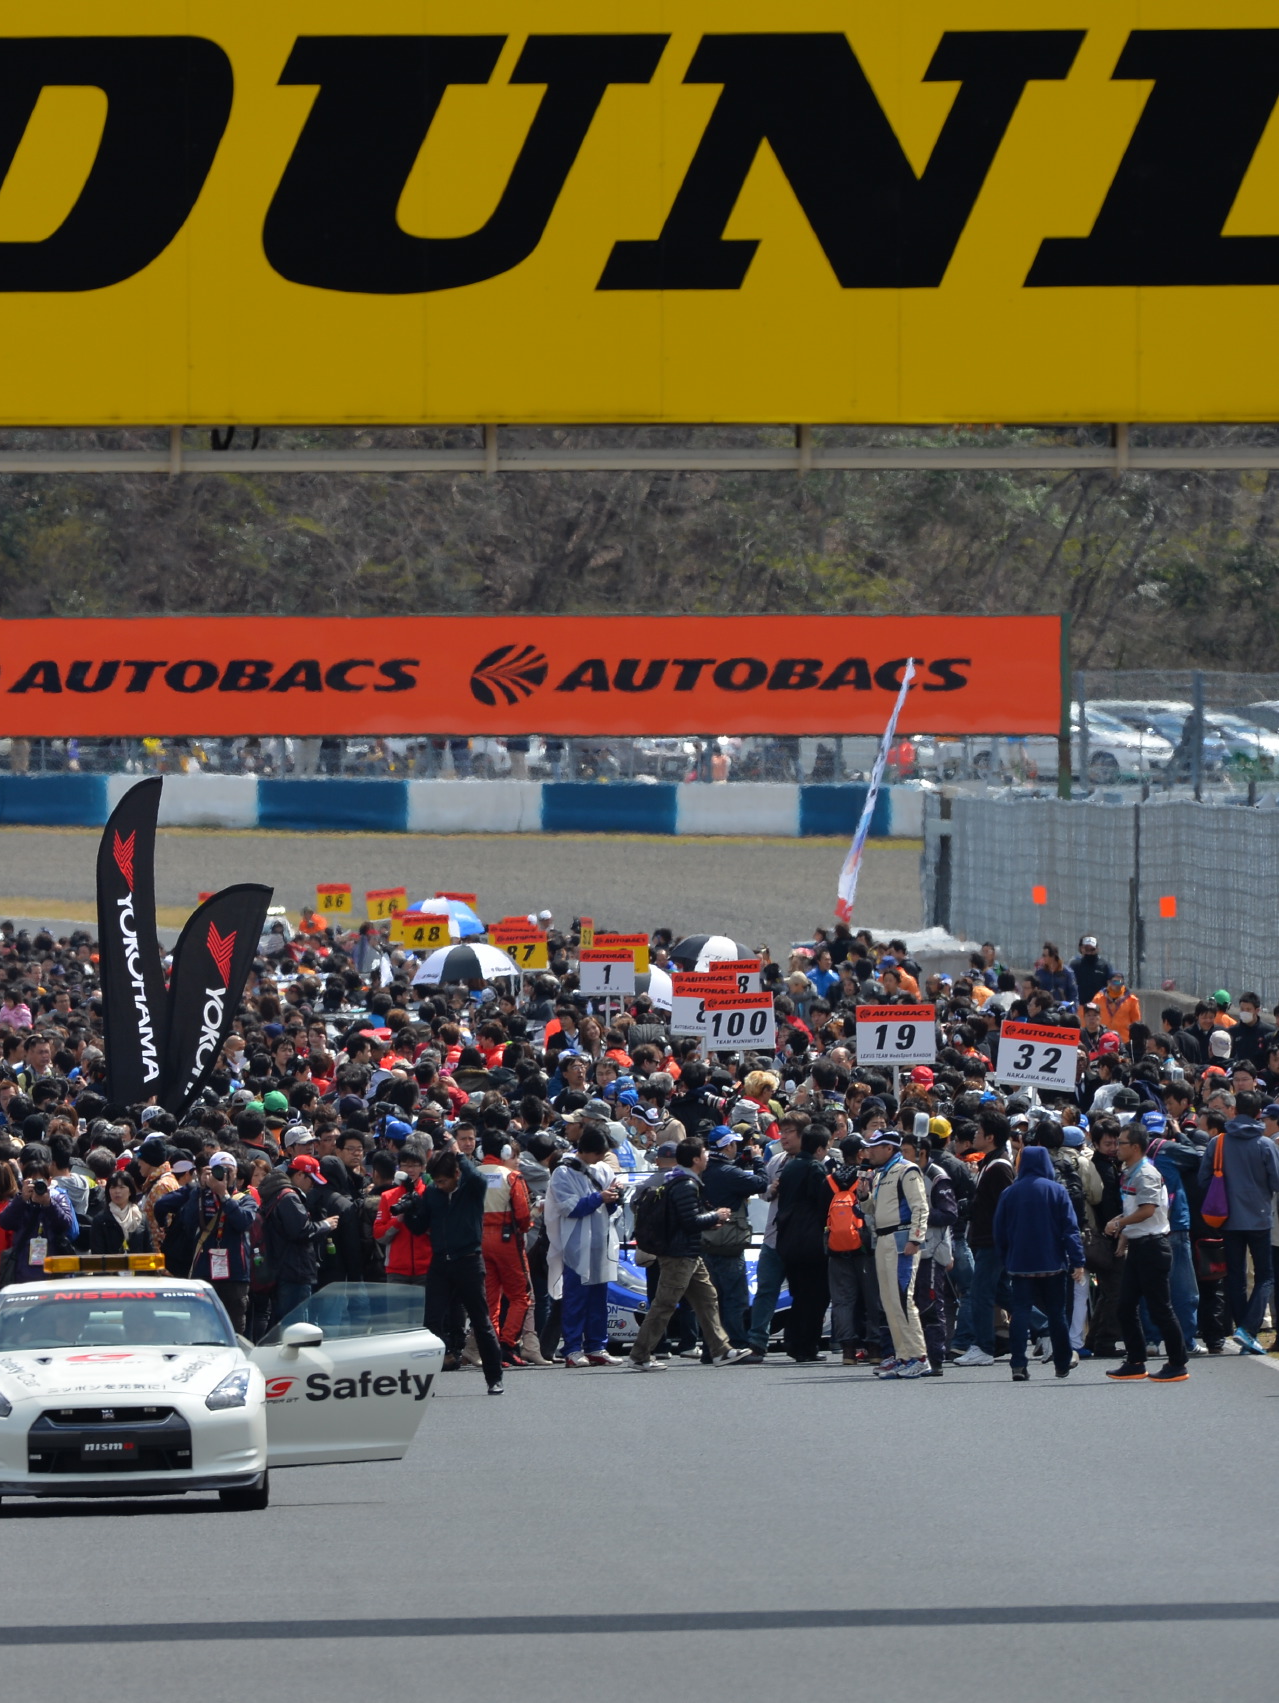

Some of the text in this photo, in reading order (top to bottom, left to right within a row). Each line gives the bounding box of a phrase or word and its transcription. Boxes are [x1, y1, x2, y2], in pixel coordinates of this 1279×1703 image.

[6, 660, 421, 696] AUTOBACS
[553, 658, 972, 694] AUTOBACS
[413, 926, 442, 942] 48
[603, 936, 646, 944] AUTOBACS
[507, 944, 537, 962] 87
[602, 964, 613, 985] 1
[685, 975, 734, 983] AUTOBACS
[117, 891, 160, 1083] YOKOHAMA
[686, 985, 736, 995] AUTOBACS
[718, 996, 770, 1006] AUTOBACS
[872, 1009, 931, 1018] AUTOBACS
[711, 1010, 768, 1038] 100
[875, 1024, 916, 1050] 19
[1017, 1028, 1076, 1041] AUTOBACS
[1013, 1044, 1062, 1074] 32
[1006, 1072, 1066, 1084] NAKAJIMA RACING
[53, 1291, 157, 1300] NISSAN
[305, 1368, 435, 1402] Safety
[84, 1442, 134, 1451] nismo
